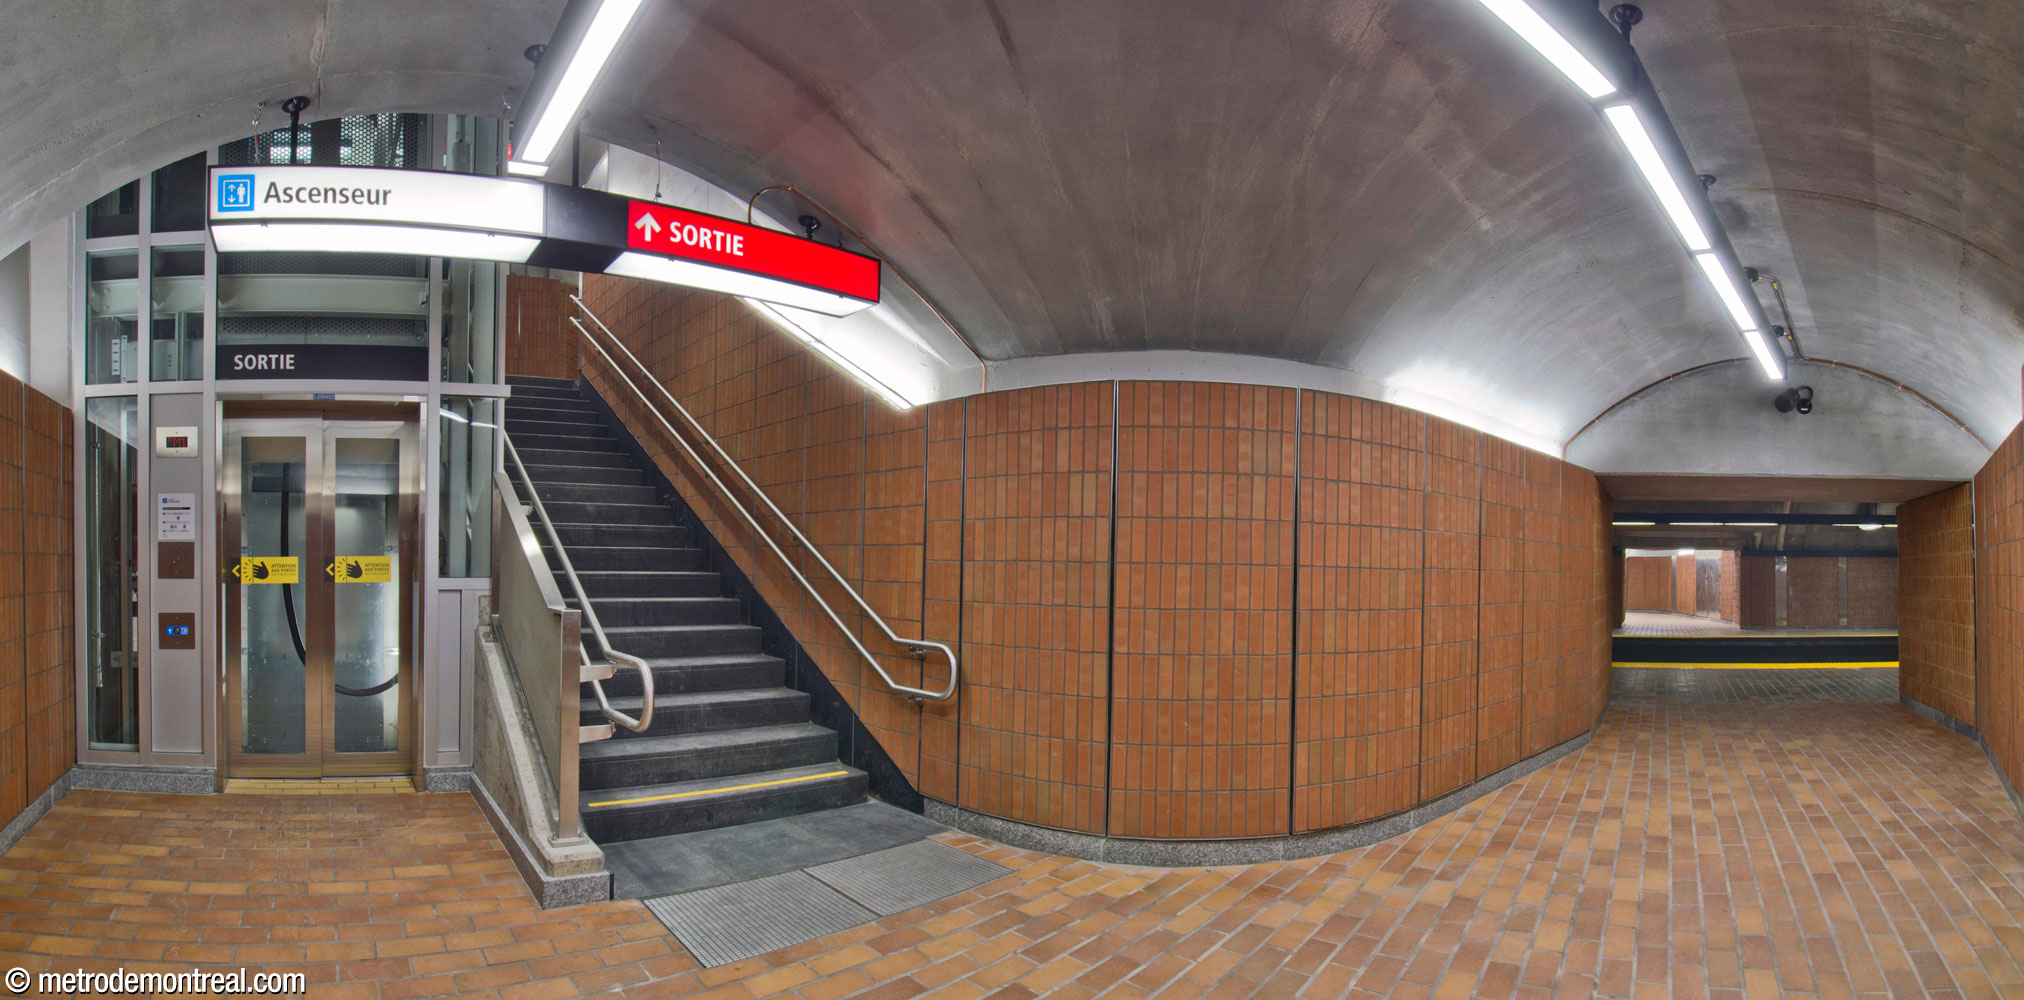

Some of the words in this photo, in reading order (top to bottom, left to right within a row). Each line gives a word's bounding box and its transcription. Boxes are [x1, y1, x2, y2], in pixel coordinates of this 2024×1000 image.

[263, 181, 392, 206] Ascenseur
[669, 221, 744, 256] SORTIE
[233, 354, 295, 370] SORTIE
